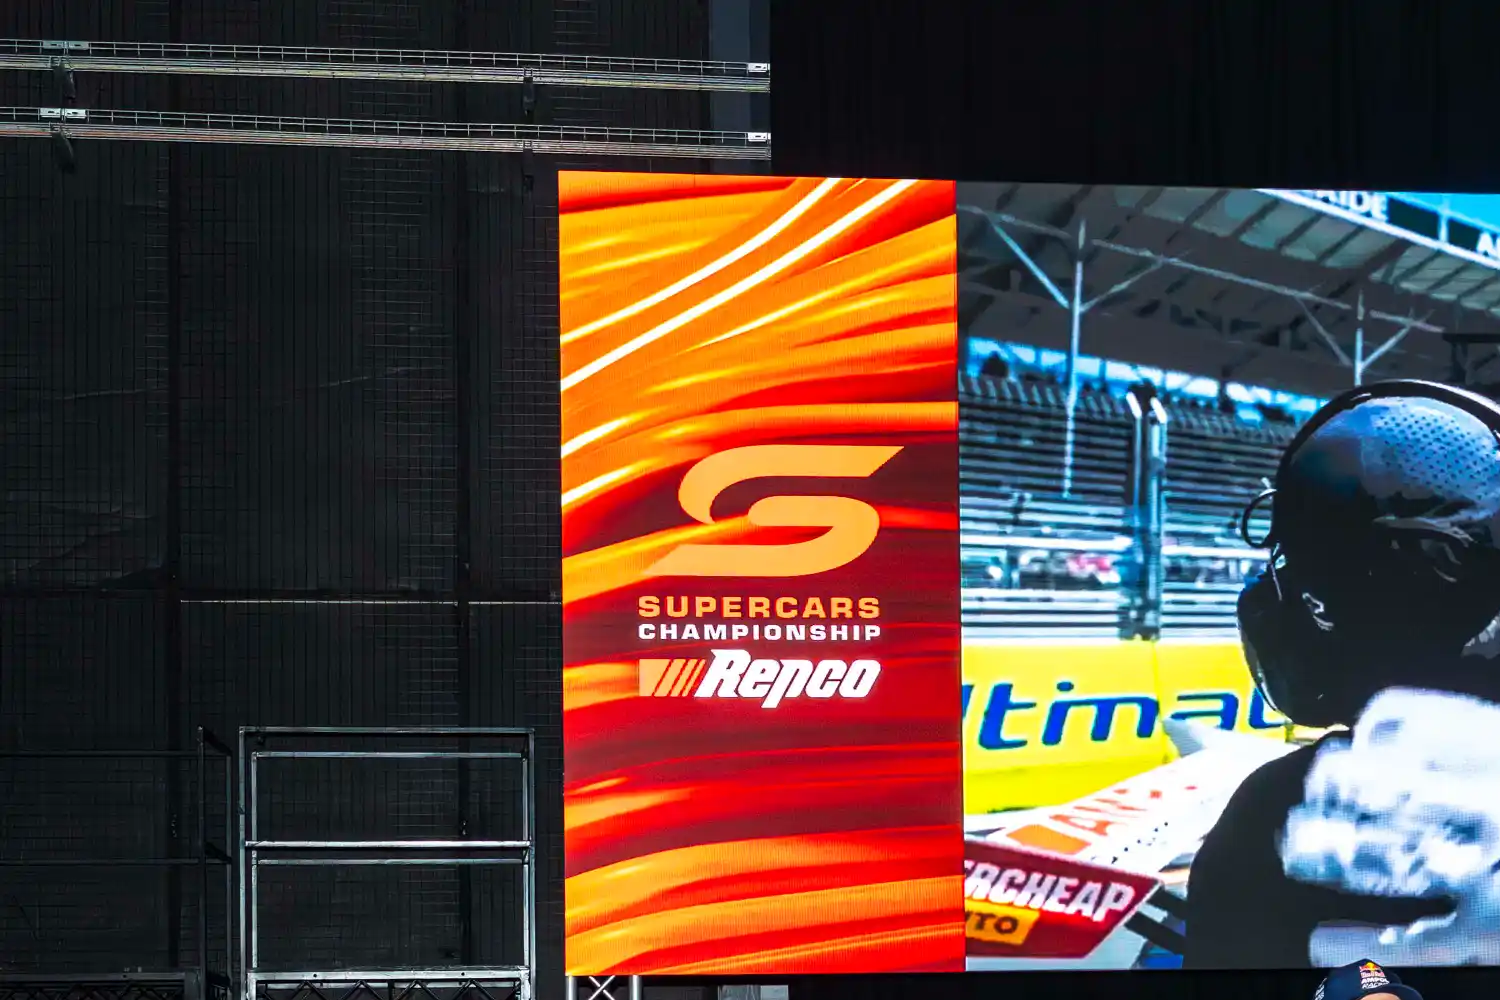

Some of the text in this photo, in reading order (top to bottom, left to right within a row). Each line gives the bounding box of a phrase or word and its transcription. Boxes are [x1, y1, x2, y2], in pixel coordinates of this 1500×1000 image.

[637, 596, 881, 619] SUPERCARS
[637, 624, 882, 641] CHAMPIONSHIP
[694, 648, 882, 709] Repco
